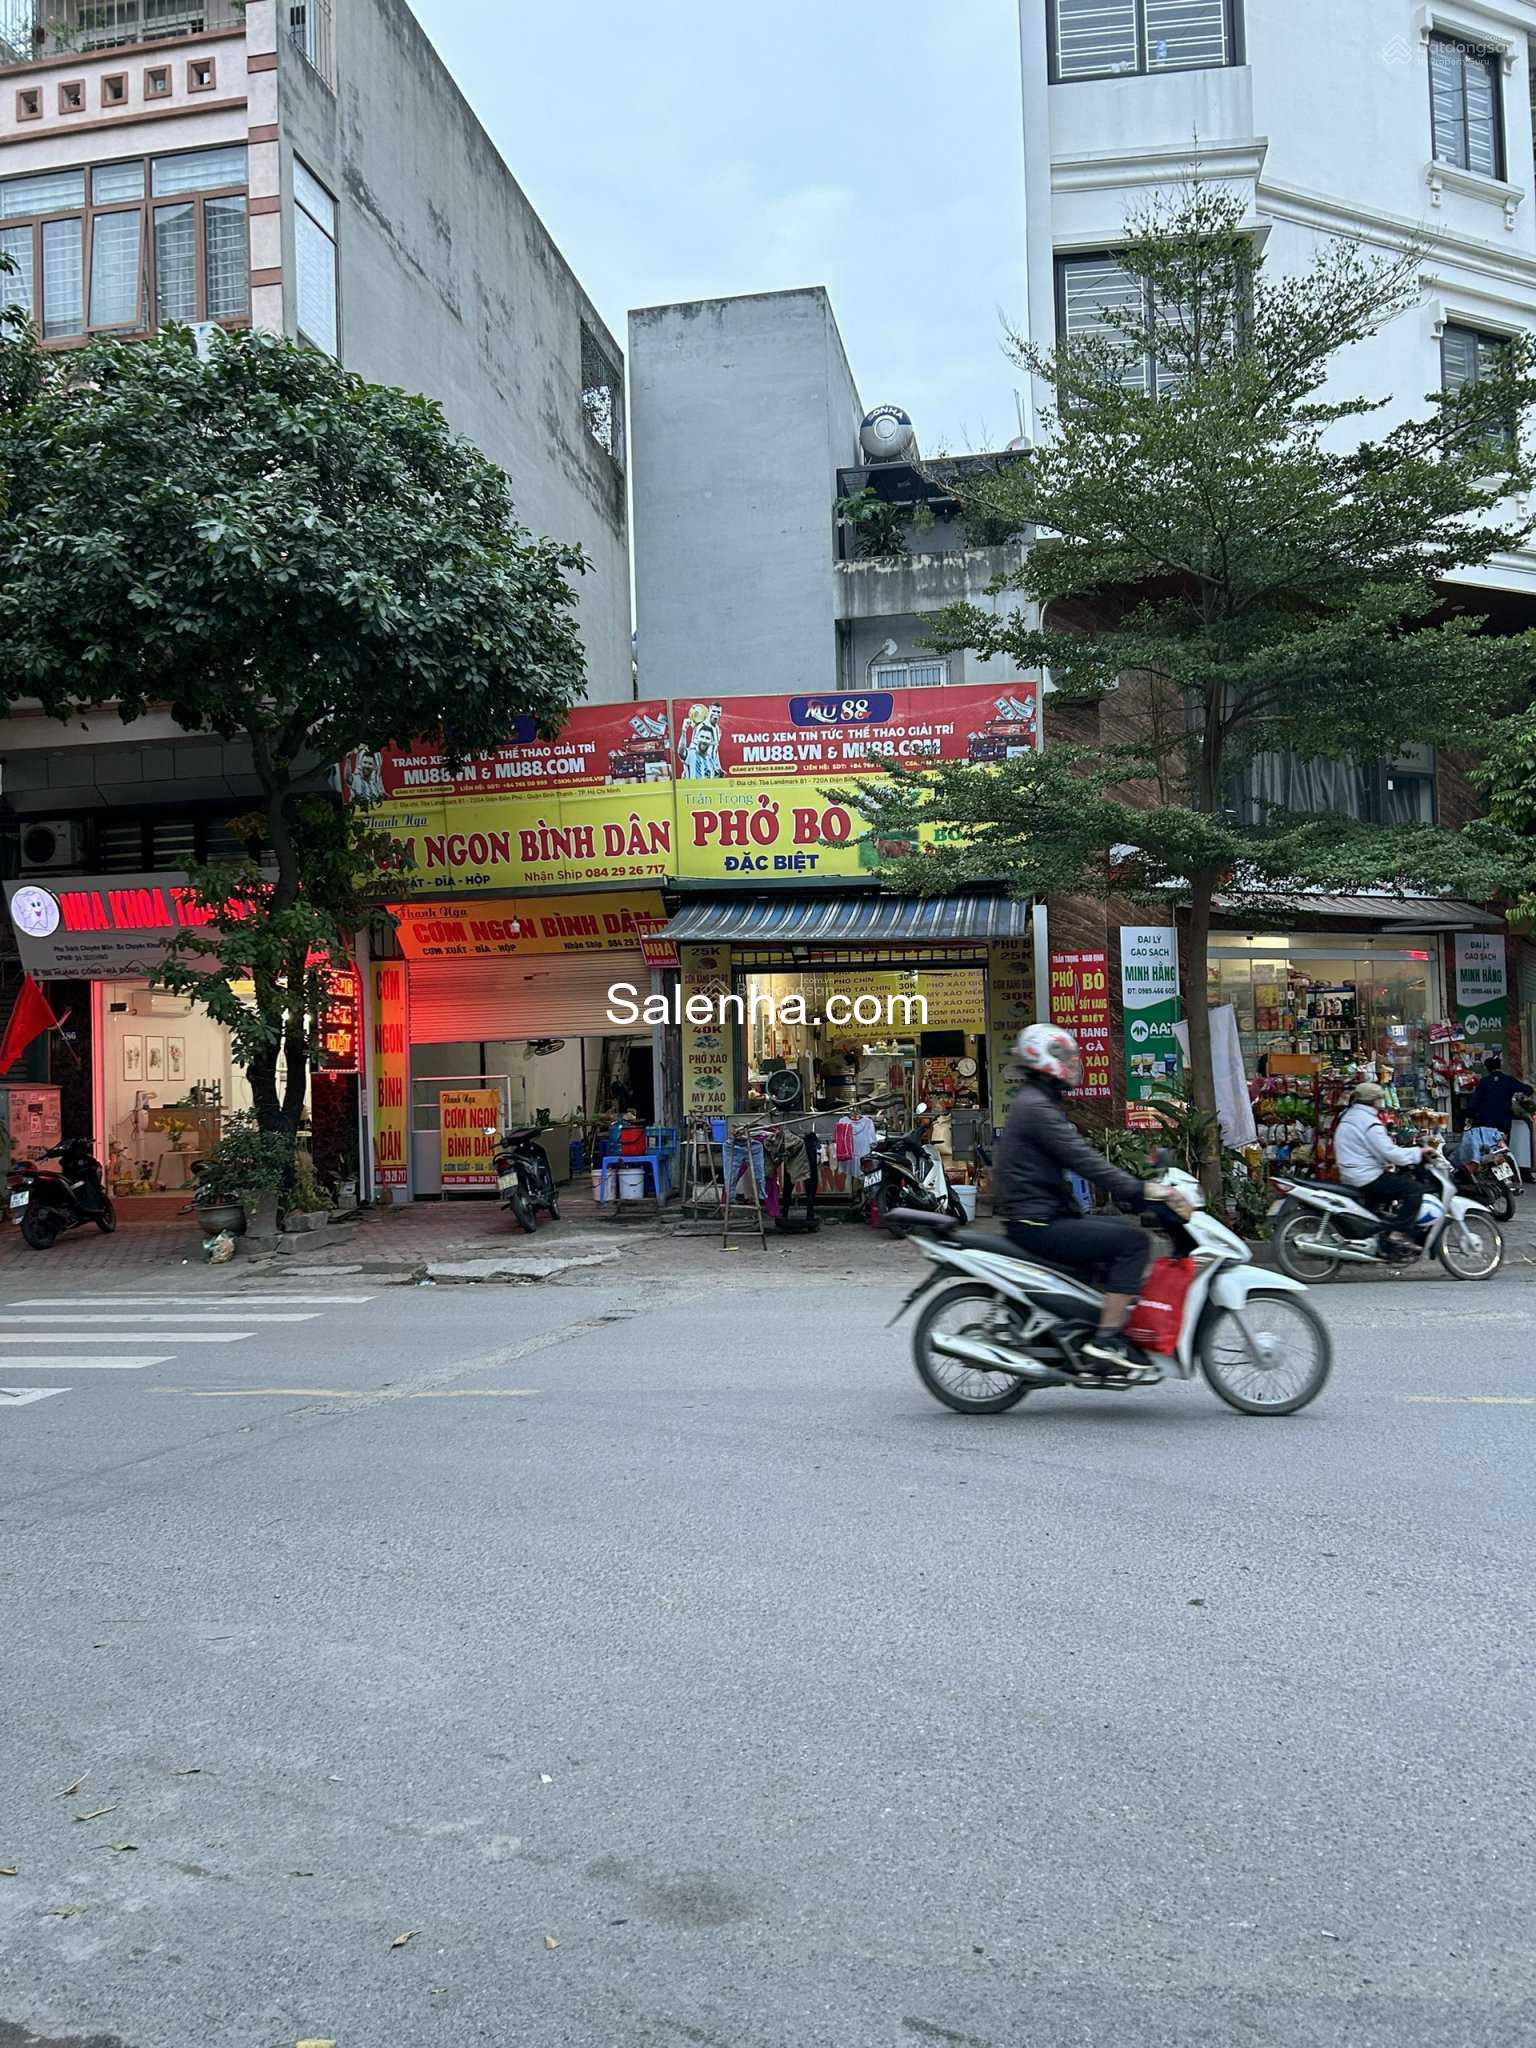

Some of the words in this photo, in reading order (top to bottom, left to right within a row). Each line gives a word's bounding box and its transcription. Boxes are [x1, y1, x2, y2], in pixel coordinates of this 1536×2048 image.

[732, 733, 770, 744] TRANG
[773, 732, 797, 742] XEM
[799, 730, 818, 741] TIN
[821, 727, 843, 741] TỨC
[848, 725, 870, 738] THẾ
[873, 727, 905, 738] THAO
[909, 723, 932, 736] GIẢI
[935, 722, 954, 735] TRÍ
[498, 746, 519, 760] THẾ
[521, 746, 550, 758] THAO
[554, 742, 577, 756] GIẢI
[578, 741, 596, 754] TRÍ
[744, 744, 821, 762] MU88.VN
[827, 746, 837, 758] &
[392, 756, 427, 767] TRANG
[481, 767, 491, 778] &
[495, 757, 586, 780] MU88.COM
[692, 794, 780, 846] PHỞ
[424, 831, 511, 869] NGON
[518, 819, 596, 862] BÌNH
[602, 813, 671, 857] DÂN
[724, 852, 769, 874] ĐẶC
[774, 850, 820, 873] BIỆT
[465, 872, 491, 887] HỘP
[524, 870, 555, 882] Nhận
[558, 868, 582, 881] Ship
[585, 866, 609, 878] 084
[612, 866, 626, 877] 29
[629, 865, 644, 876] 26
[646, 864, 666, 875] 717
[59, 891, 110, 932] NHA
[107, 888, 173, 930] KHOA
[412, 920, 468, 944] CƠM
[469, 918, 538, 941] NGON
[540, 911, 600, 938] BÌNH
[1000, 951, 1033, 960] 25K
[376, 968, 400, 1000] CƠM
[1052, 966, 1074, 988] PHỞ
[1082, 968, 1105, 990] BÒ
[1125, 966, 1149, 981] MINH
[1460, 967, 1480, 982] MINH
[1001, 991, 1034, 1001] 30K
[1052, 993, 1075, 1013] BÚN
[375, 1023, 403, 1054] NGON
[692, 1026, 722, 1034] 40K
[1080, 1028, 1108, 1037] RANG
[1085, 1040, 1104, 1051] GÀ
[693, 1066, 722, 1075] 30K
[378, 1071, 402, 1108] BÌNH
[444, 1106, 466, 1129] CƠM
[470, 1107, 497, 1129] NGON
[380, 1124, 401, 1161] DÂN
[447, 1133, 471, 1157] BÌNH
